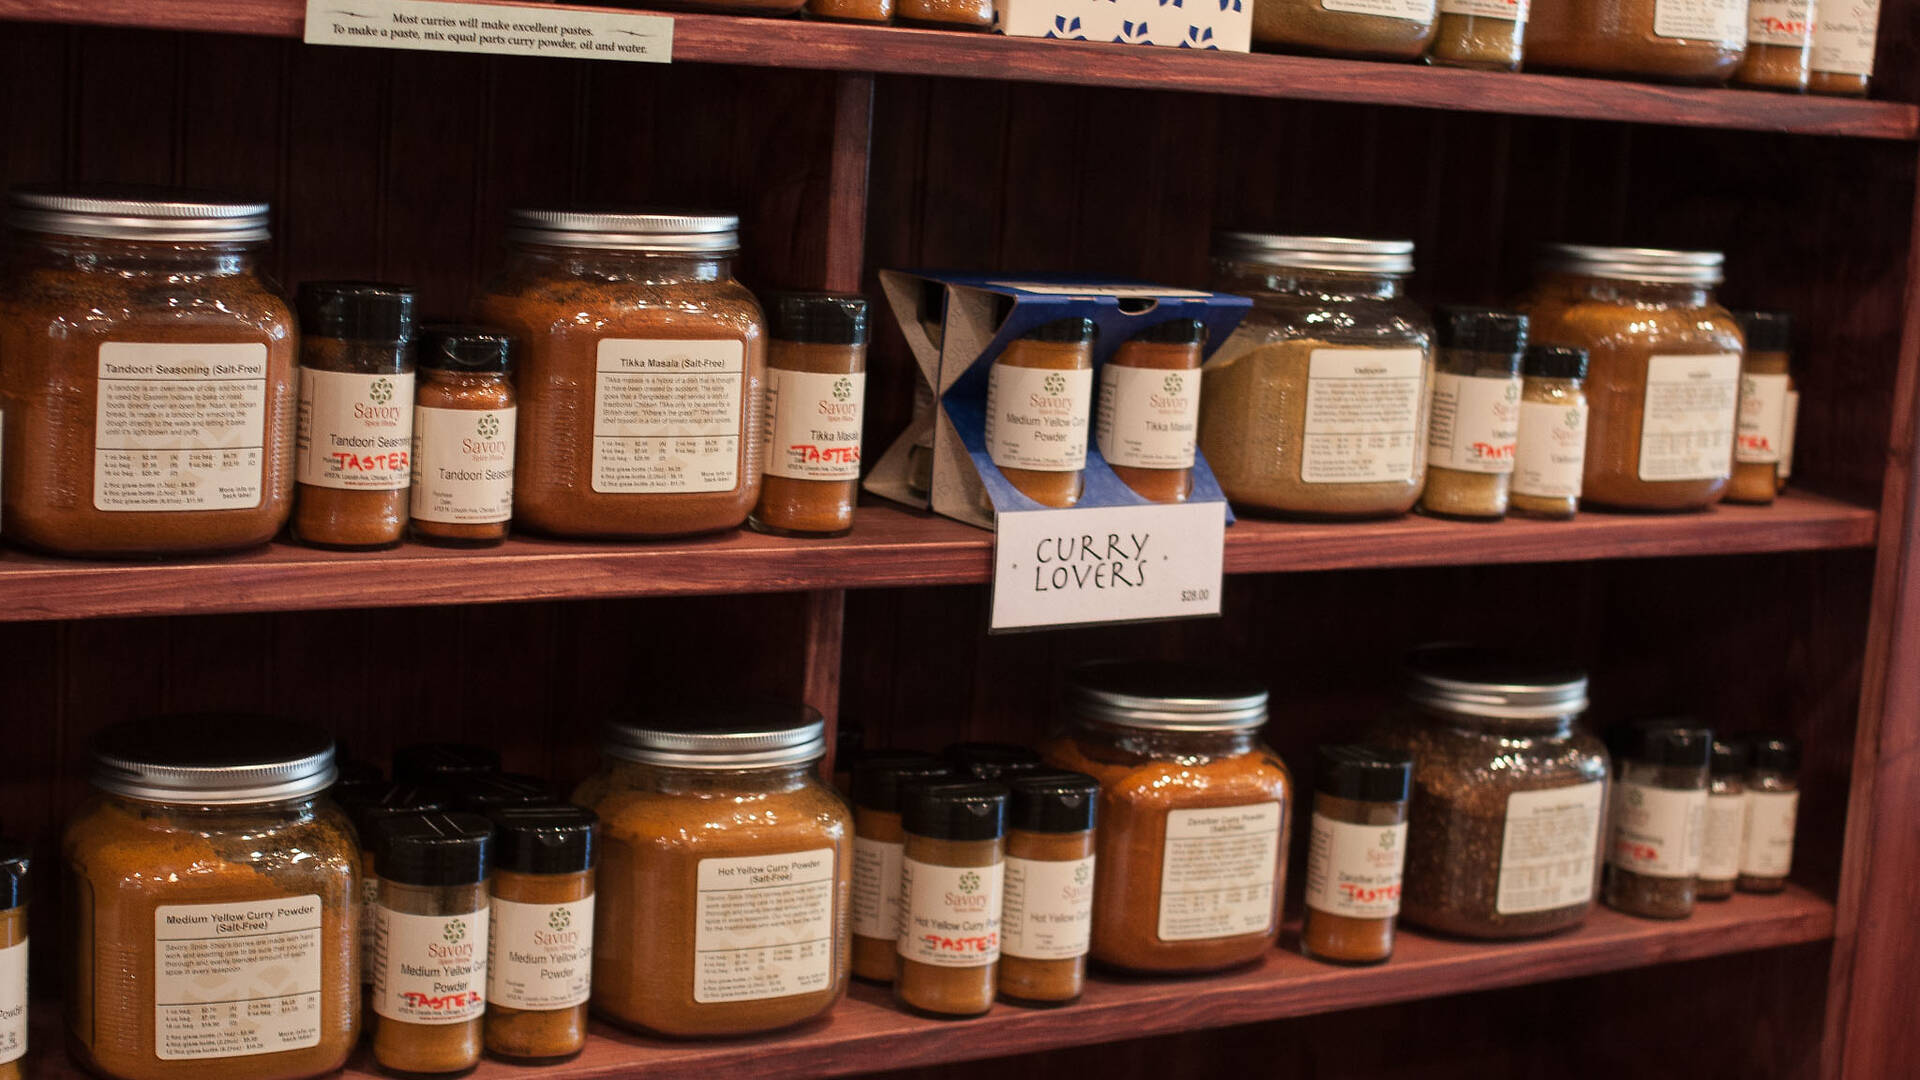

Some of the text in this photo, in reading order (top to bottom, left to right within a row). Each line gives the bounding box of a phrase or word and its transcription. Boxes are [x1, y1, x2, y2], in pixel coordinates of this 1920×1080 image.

[392, 11, 418, 24] Most
[420, 15, 456, 26] curries
[459, 18, 478, 28] will
[481, 20, 510, 31] make
[512, 22, 558, 34] excellent
[332, 23, 345, 34] To
[347, 25, 379, 36] make
[380, 29, 388, 37] a
[424, 31, 446, 40] mix
[448, 33, 476, 45] equal
[480, 35, 506, 45] parts
[508, 38, 536, 49] curry
[580, 41, 593, 50] oil
[595, 42, 616, 52] and
[105, 363, 262, 377] Tandoori Seasoning (Salt-Free)
[620, 358, 725, 369] Tikka Masala (Salt-Free)
[819, 400, 856, 418] Savory
[1030, 394, 1071, 411] Savory
[354, 402, 400, 421] Savory
[1006, 412, 1041, 426] Medium
[329, 433, 375, 448] Tandoori
[810, 430, 834, 441] Tikka
[1034, 430, 1067, 442] Powder
[462, 438, 505, 456] Savory
[332, 452, 409, 472] TASTER
[438, 466, 482, 481] Tandoori
[1036, 533, 1150, 563] CURRY
[1035, 559, 1148, 592] LOVERS
[718, 867, 735, 877] Hot
[736, 865, 764, 875] Yellow
[766, 864, 789, 874] Curry
[944, 892, 986, 908] Savory
[166, 905, 315, 925] Medium Yellow Curry Powder
[216, 920, 268, 934] (Salt-Free)
[914, 917, 929, 928] Hot
[931, 919, 960, 930] Yellow
[962, 920, 985, 932] Curry
[534, 930, 578, 947] Savory
[428, 943, 473, 959] Savory
[508, 951, 547, 964] Medium
[550, 952, 577, 964] Yellow
[400, 963, 441, 977] Medium
[442, 965, 472, 977] Yellow
[540, 968, 574, 980] Powder
[433, 982, 468, 993] Powder
